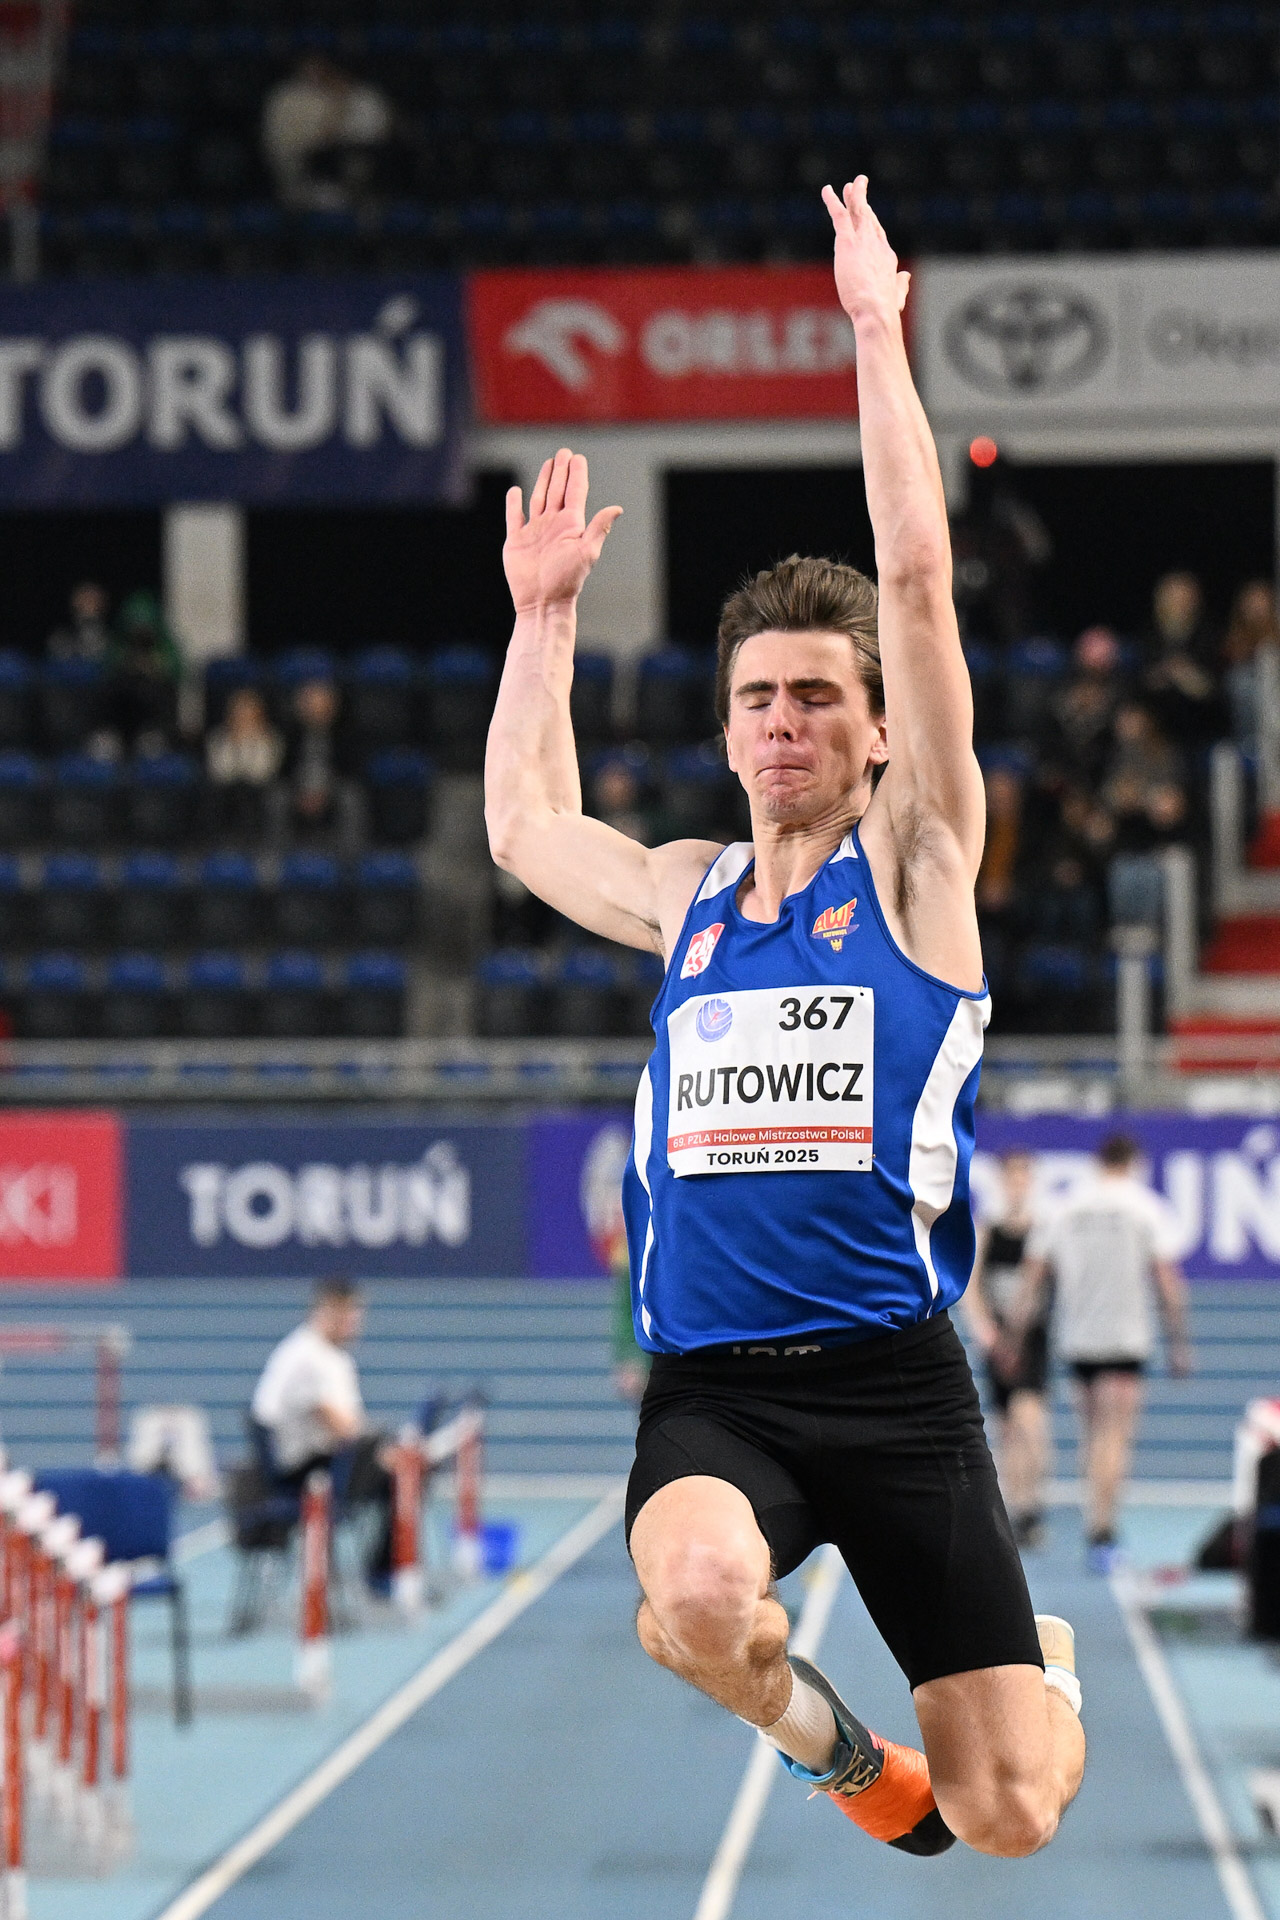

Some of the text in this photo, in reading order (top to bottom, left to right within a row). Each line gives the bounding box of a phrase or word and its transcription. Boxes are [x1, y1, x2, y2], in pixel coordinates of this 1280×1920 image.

[812, 898, 858, 934] AWF
[779, 996, 855, 1031] 367
[677, 1062, 864, 1111] RUTOWICZ
[673, 1128, 865, 1149] 69. PZLA Halowe Mistrzostwa Polski
[707, 1147, 819, 1166] TORUŃ 2025
[181, 1139, 472, 1249] TORUŃ
